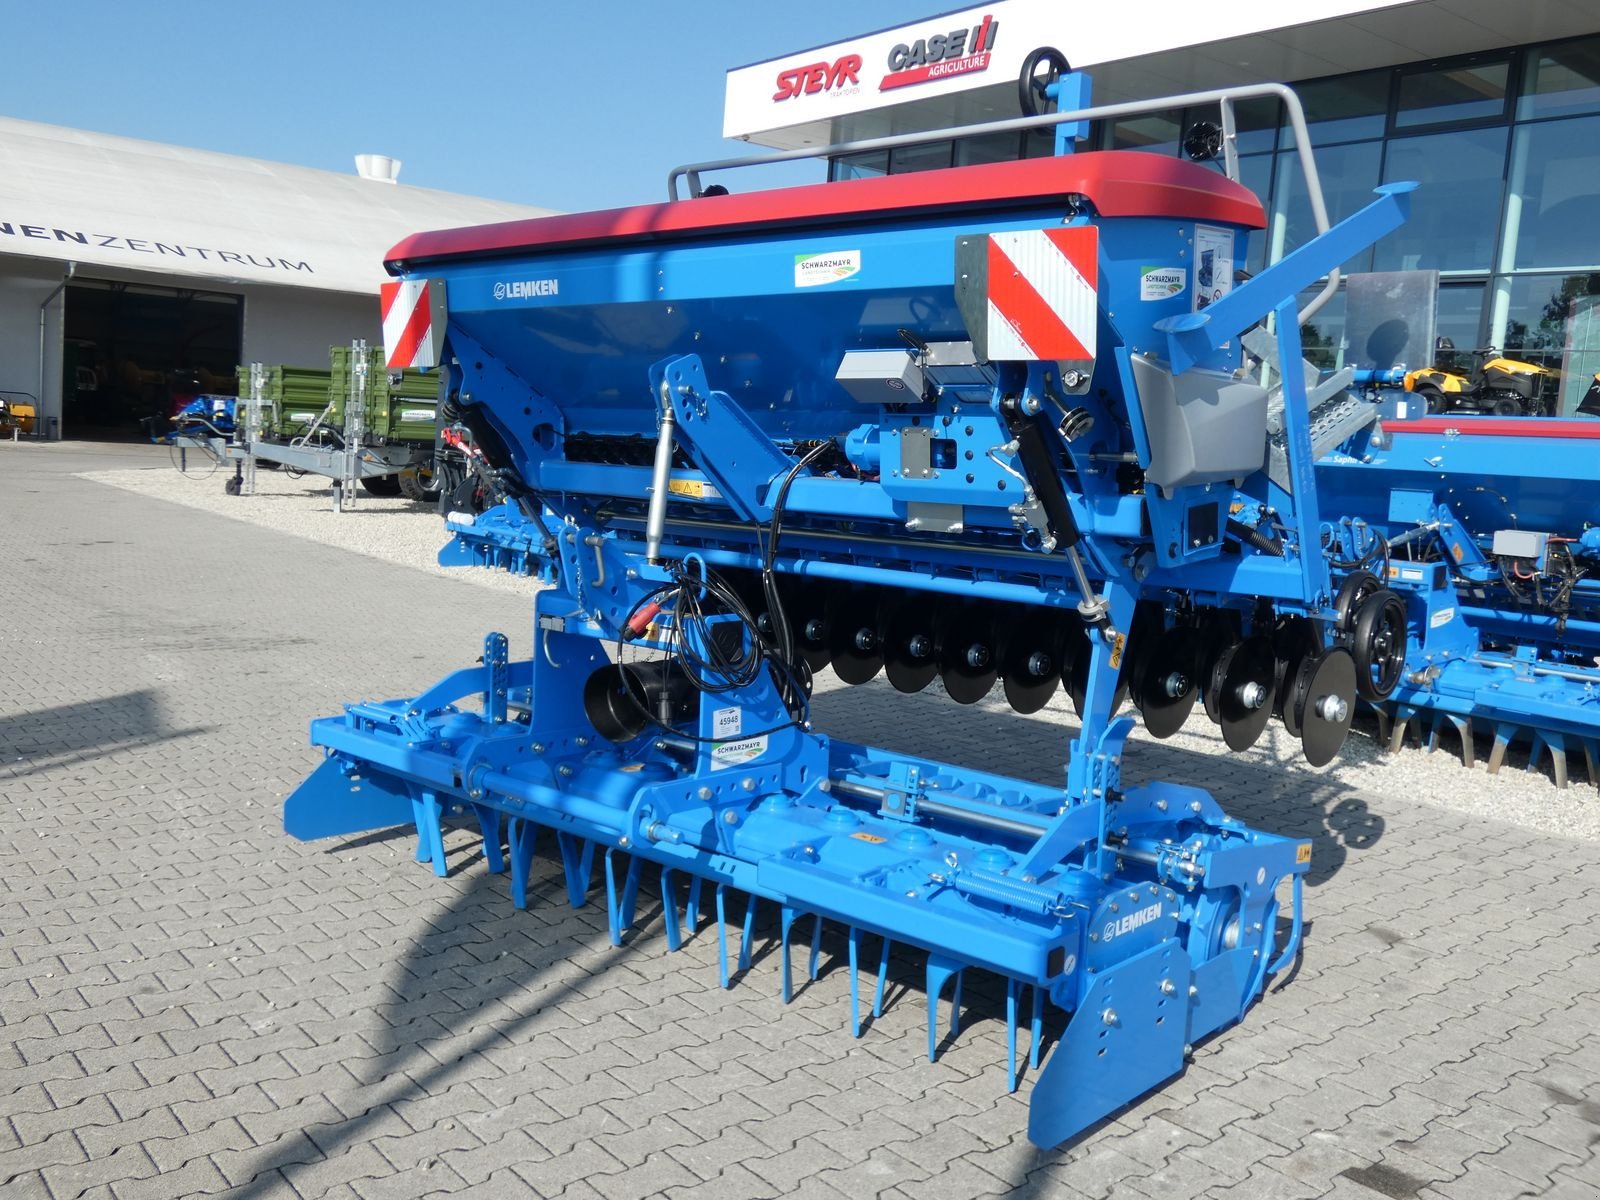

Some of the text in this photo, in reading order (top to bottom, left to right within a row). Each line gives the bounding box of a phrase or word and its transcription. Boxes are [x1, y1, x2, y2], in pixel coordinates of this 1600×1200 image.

[887, 28, 969, 72] CASE
[928, 56, 985, 77] AGRICULTURE
[772, 53, 863, 102] STEYR
[801, 258, 852, 270] SCHWARZMAYR
[1145, 274, 1181, 283] SCHWARZMAYR
[506, 279, 559, 300] LEMKEN
[719, 715, 739, 726] 45948
[717, 741, 761, 755] SCHWARZMAYR
[1115, 902, 1162, 937] LEMKEN
